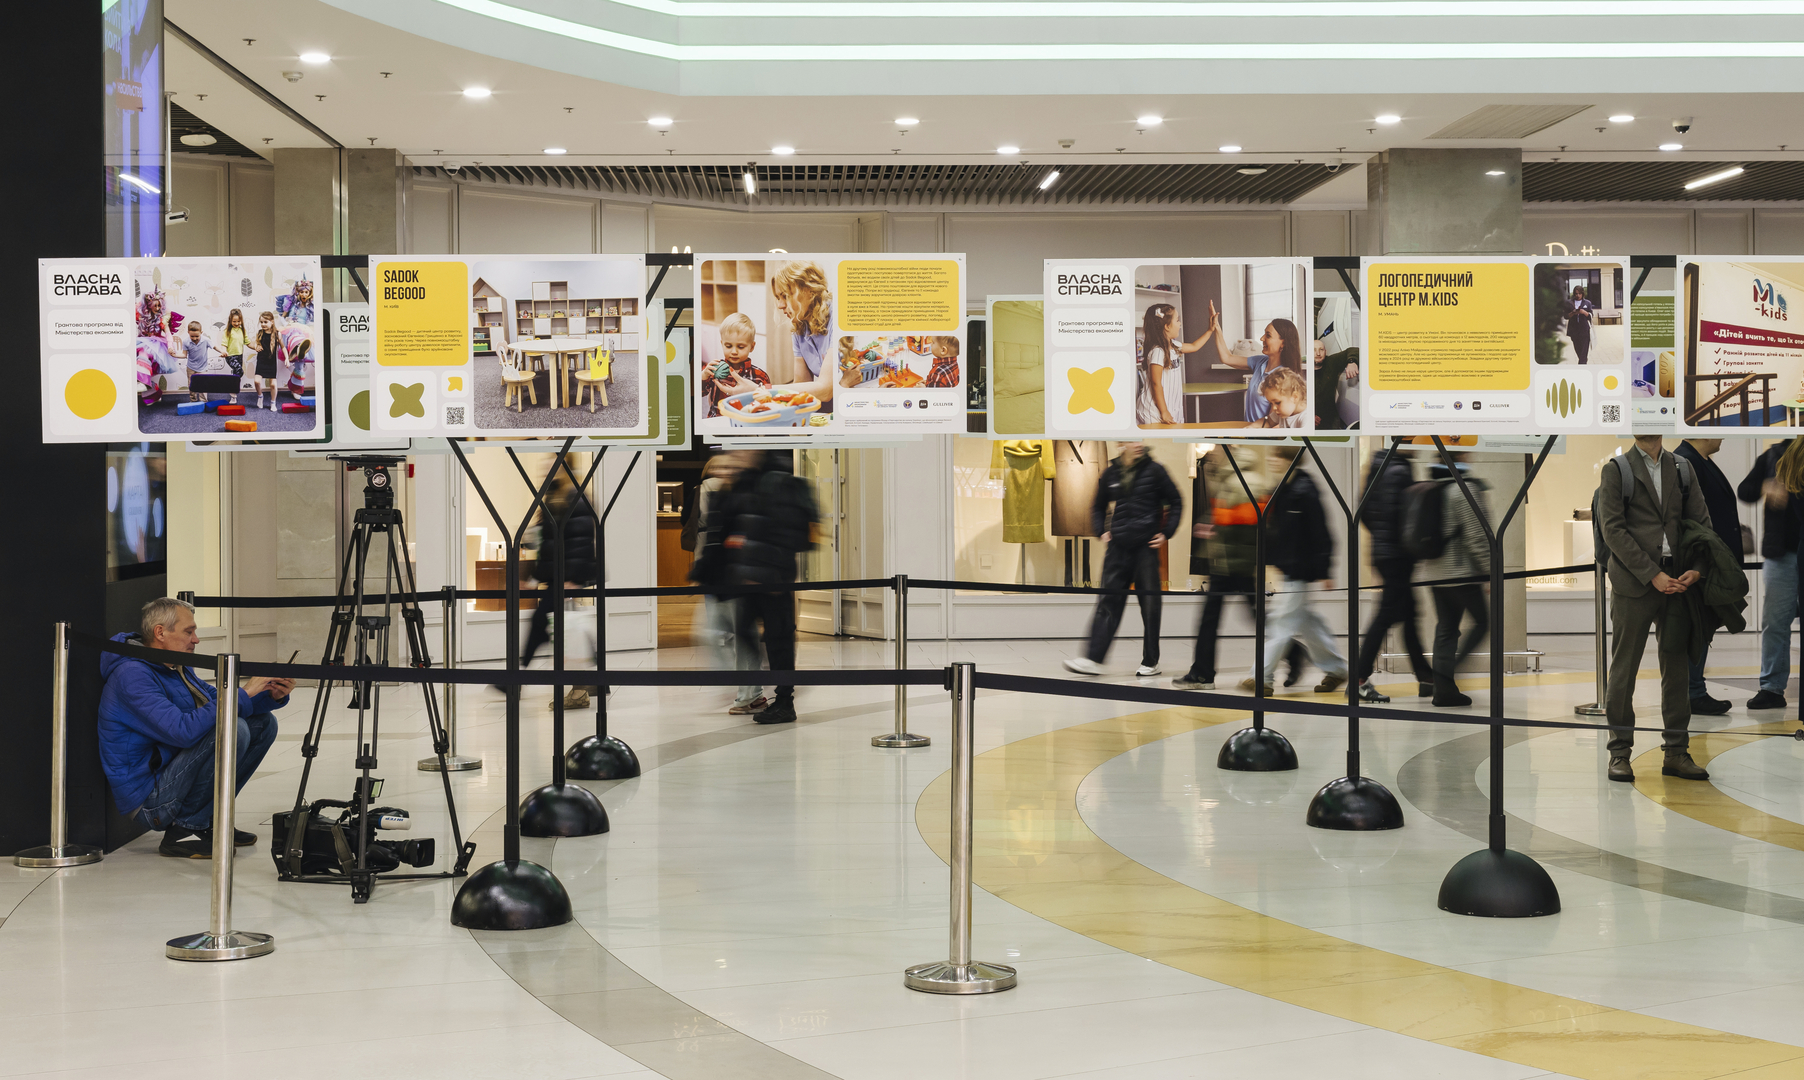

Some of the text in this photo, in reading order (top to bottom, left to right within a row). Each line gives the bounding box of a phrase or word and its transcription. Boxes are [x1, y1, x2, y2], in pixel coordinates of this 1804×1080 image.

[54, 274, 121, 284] ВЛАСНА
[384, 270, 419, 283] SADOK
[1058, 274, 1122, 284] ВЛАСНА
[1378, 271, 1473, 288] ЛОГОПЕДИЧНИЙ
[54, 285, 122, 296] СПРАВА
[384, 287, 425, 300] BEGOOD
[1058, 285, 1122, 295] СПРАВА
[1379, 292, 1458, 307] ЦЕНТР M.KIDS
[340, 315, 369, 323] ВЛА
[340, 324, 369, 332] СПР
[1714, 329, 1743, 339] «Дітей
[1746, 333, 1765, 341] вчить
